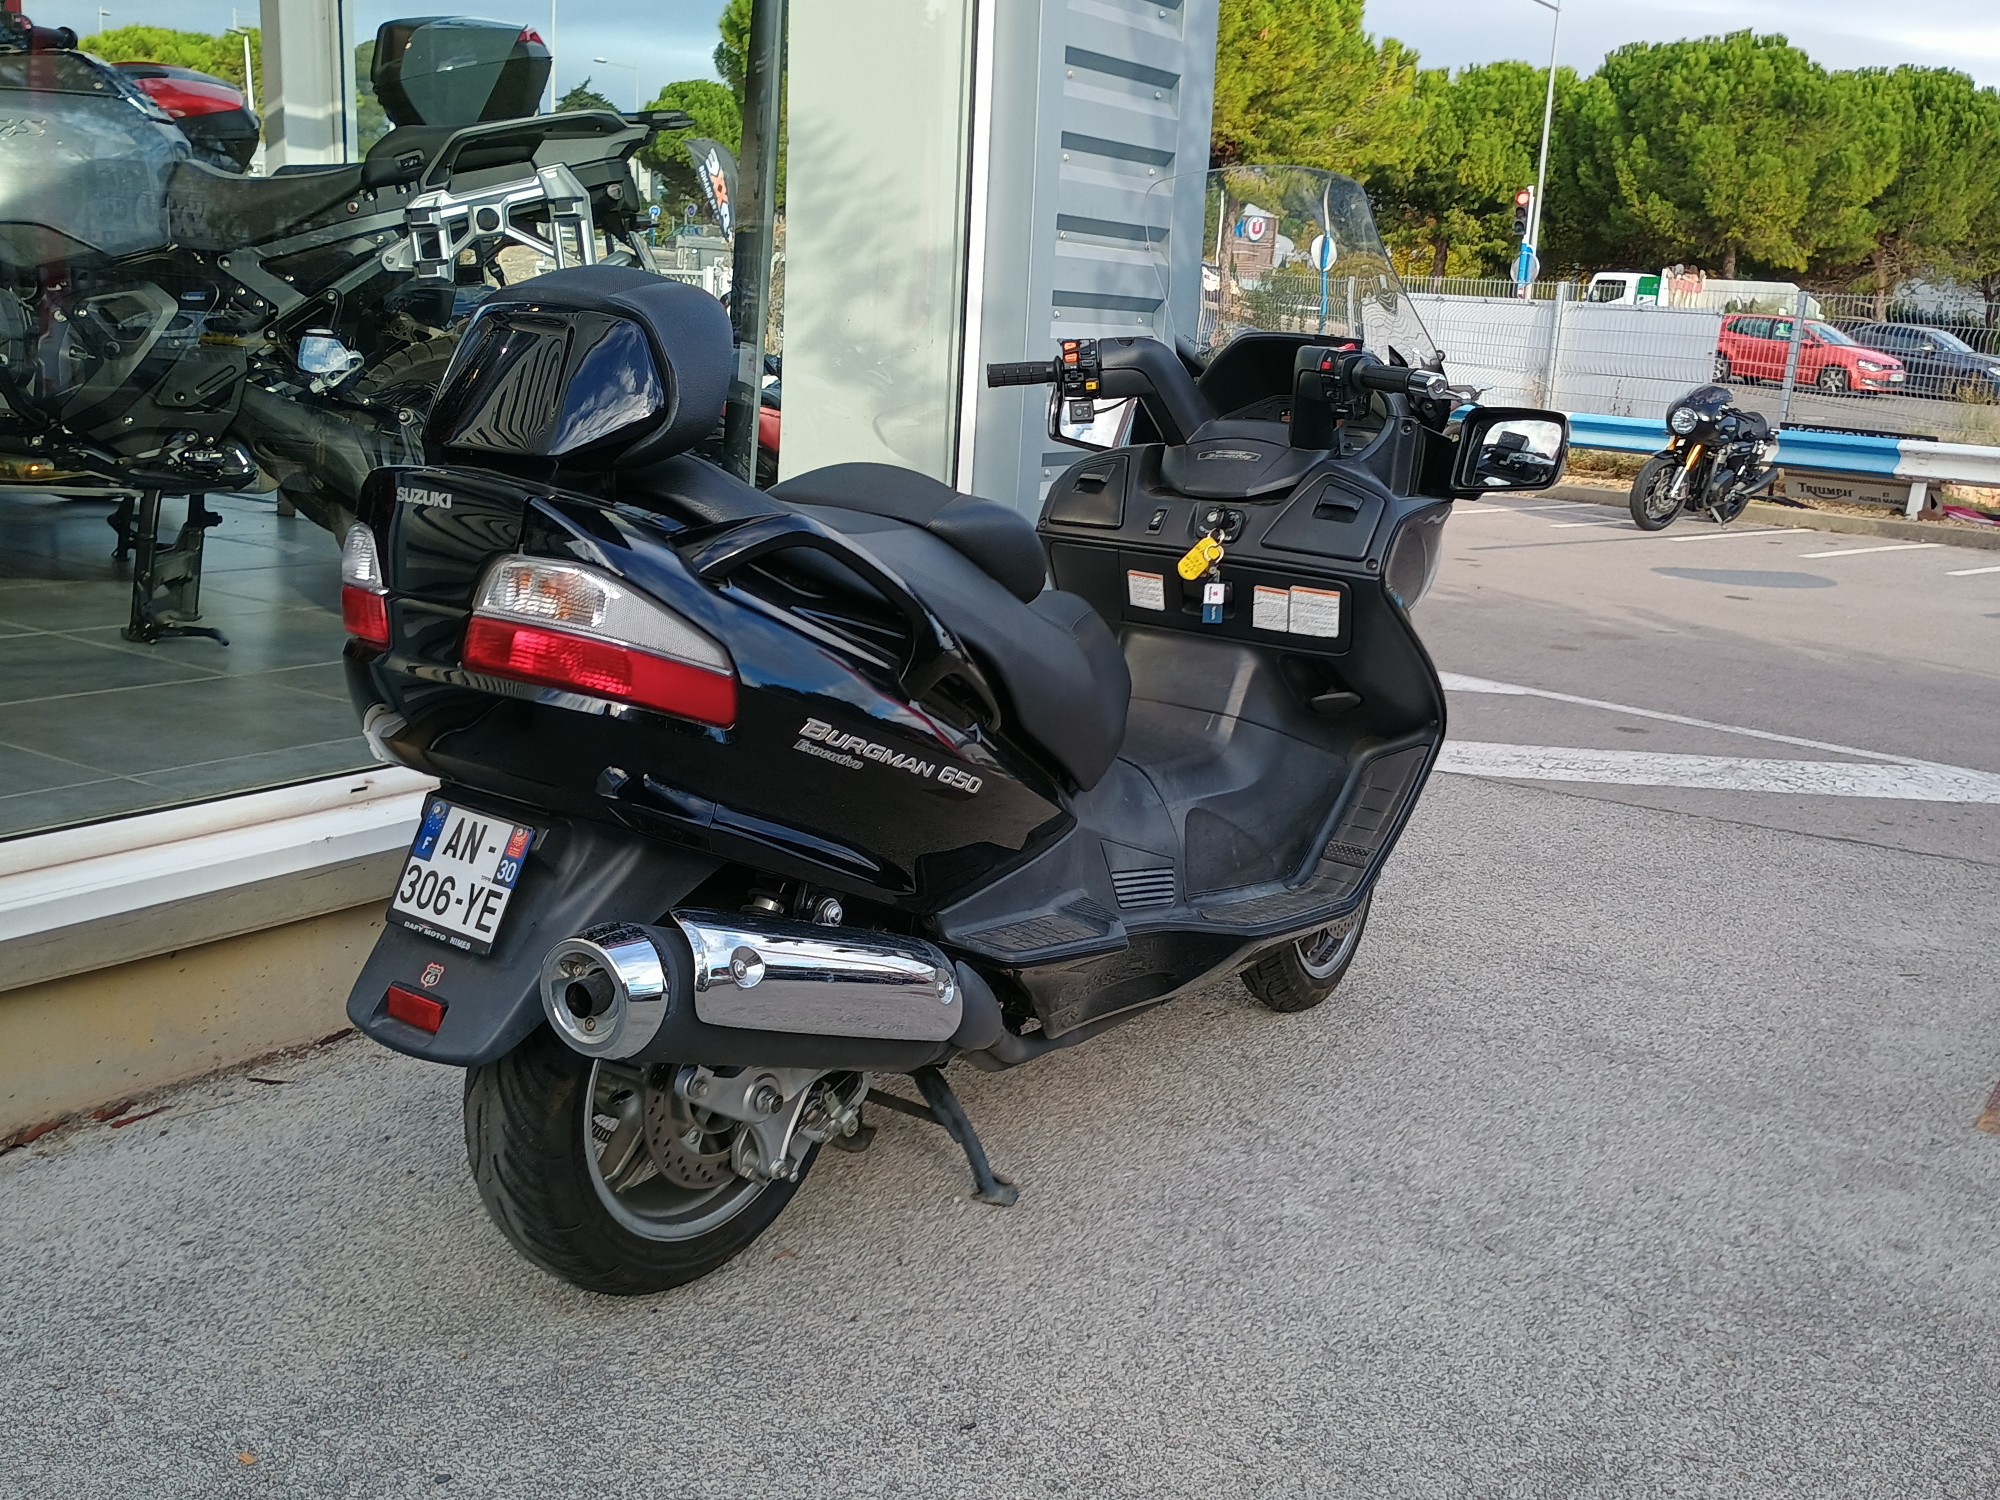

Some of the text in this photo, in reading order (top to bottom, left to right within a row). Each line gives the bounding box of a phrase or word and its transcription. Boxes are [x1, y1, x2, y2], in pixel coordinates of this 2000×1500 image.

[396, 486, 453, 509] SUZUKI
[1797, 481, 1855, 499] TRIUMPH
[798, 717, 983, 794] BURGMAN 650
[421, 836, 433, 850] F
[496, 859, 518, 883] 30
[399, 864, 504, 934] 306-YE
[403, 920, 424, 933] DAFY
[424, 928, 447, 942] MOTO
